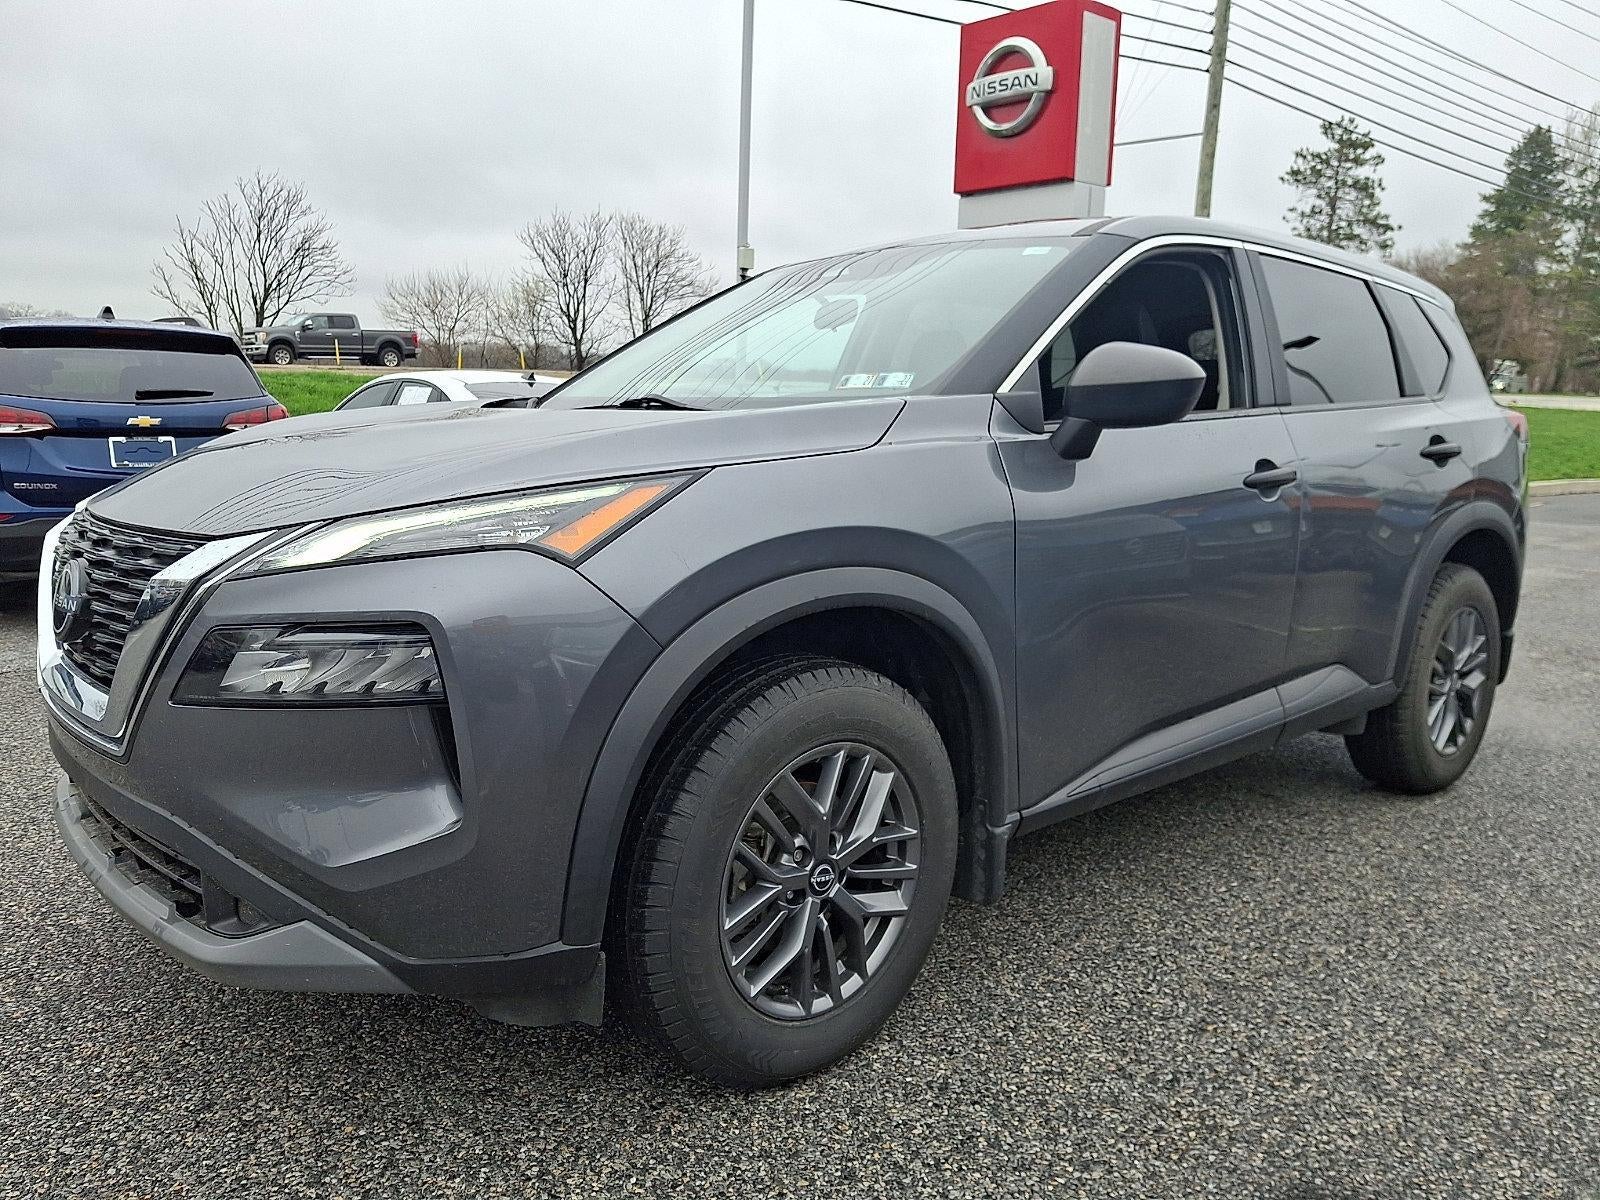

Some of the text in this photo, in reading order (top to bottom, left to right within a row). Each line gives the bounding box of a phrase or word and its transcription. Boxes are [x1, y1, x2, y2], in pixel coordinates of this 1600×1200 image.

[971, 72, 1038, 100] NISSAN
[13, 482, 58, 490] EQUINOX
[55, 593, 77, 611] SSAN
